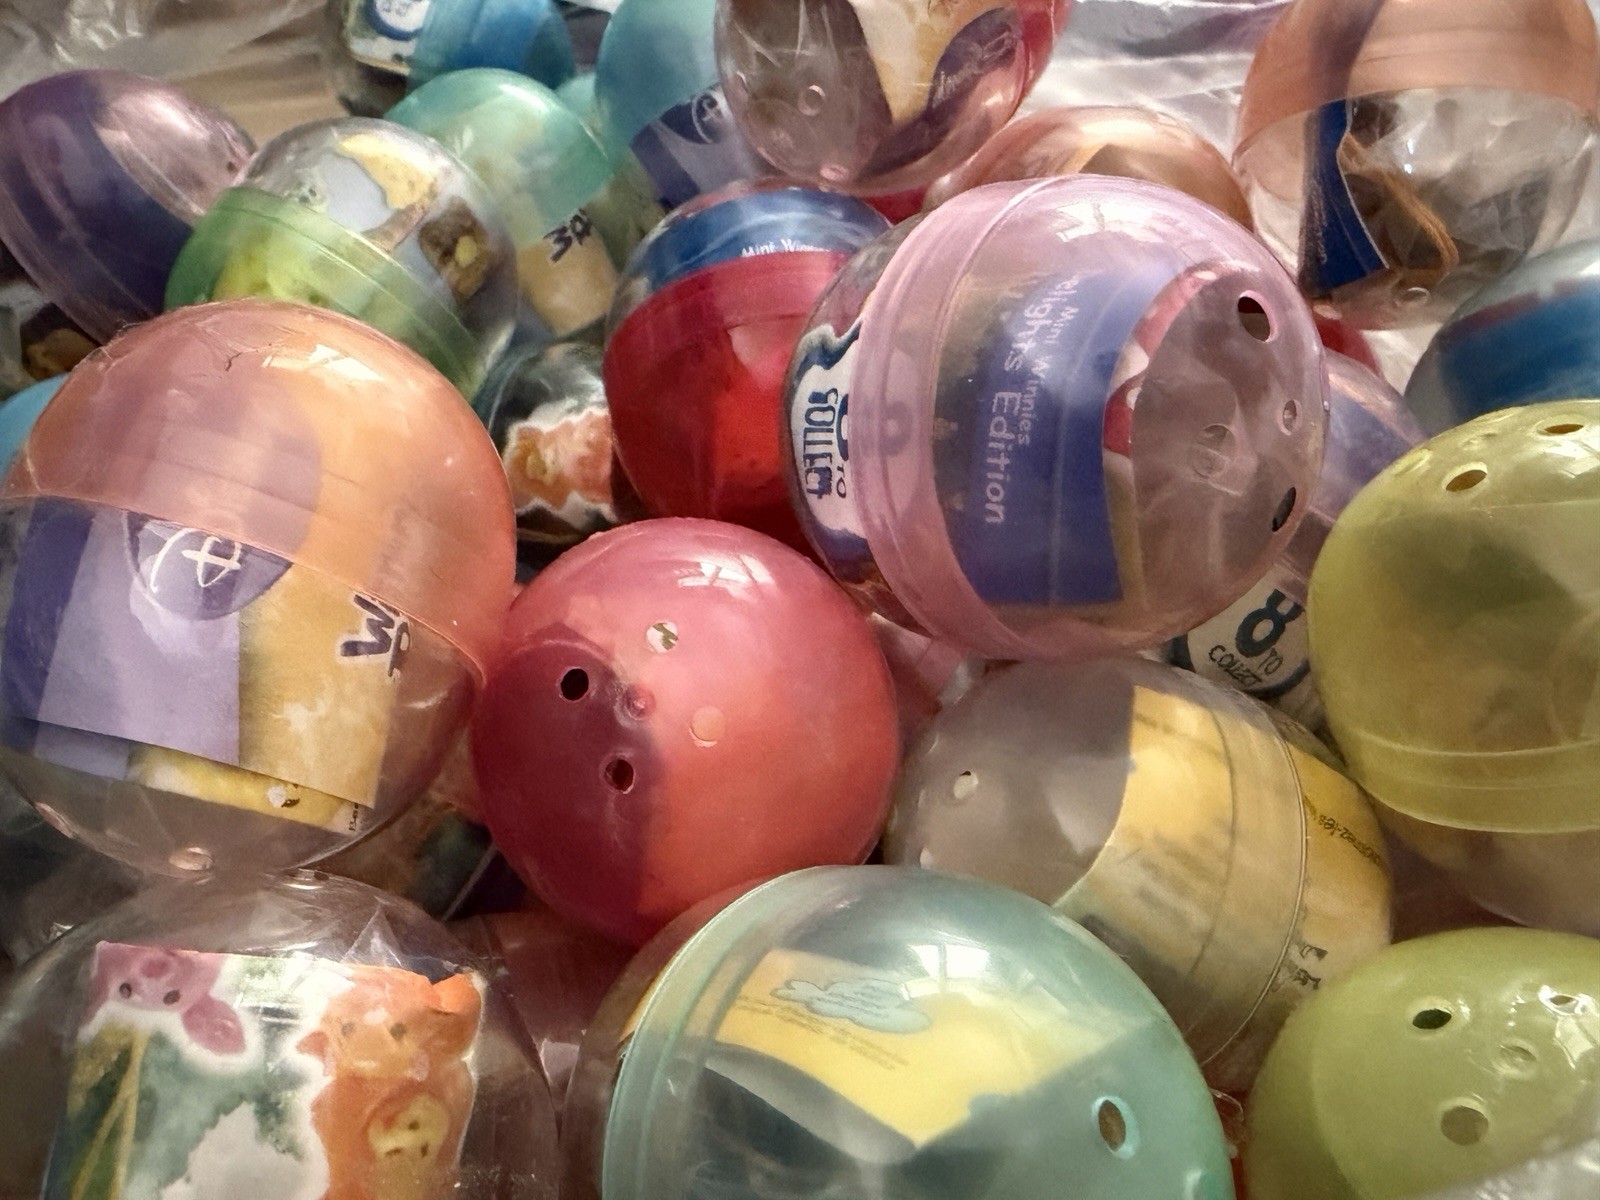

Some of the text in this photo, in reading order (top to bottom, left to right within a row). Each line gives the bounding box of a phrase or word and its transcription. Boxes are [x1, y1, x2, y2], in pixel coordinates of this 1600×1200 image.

[984, 273, 1079, 523] elights Edition
[1018, 305, 1079, 445] Mini Winnies
[803, 387, 839, 500] COLLECT
[837, 463, 847, 499] TO
[1234, 588, 1306, 676] 8 TO
